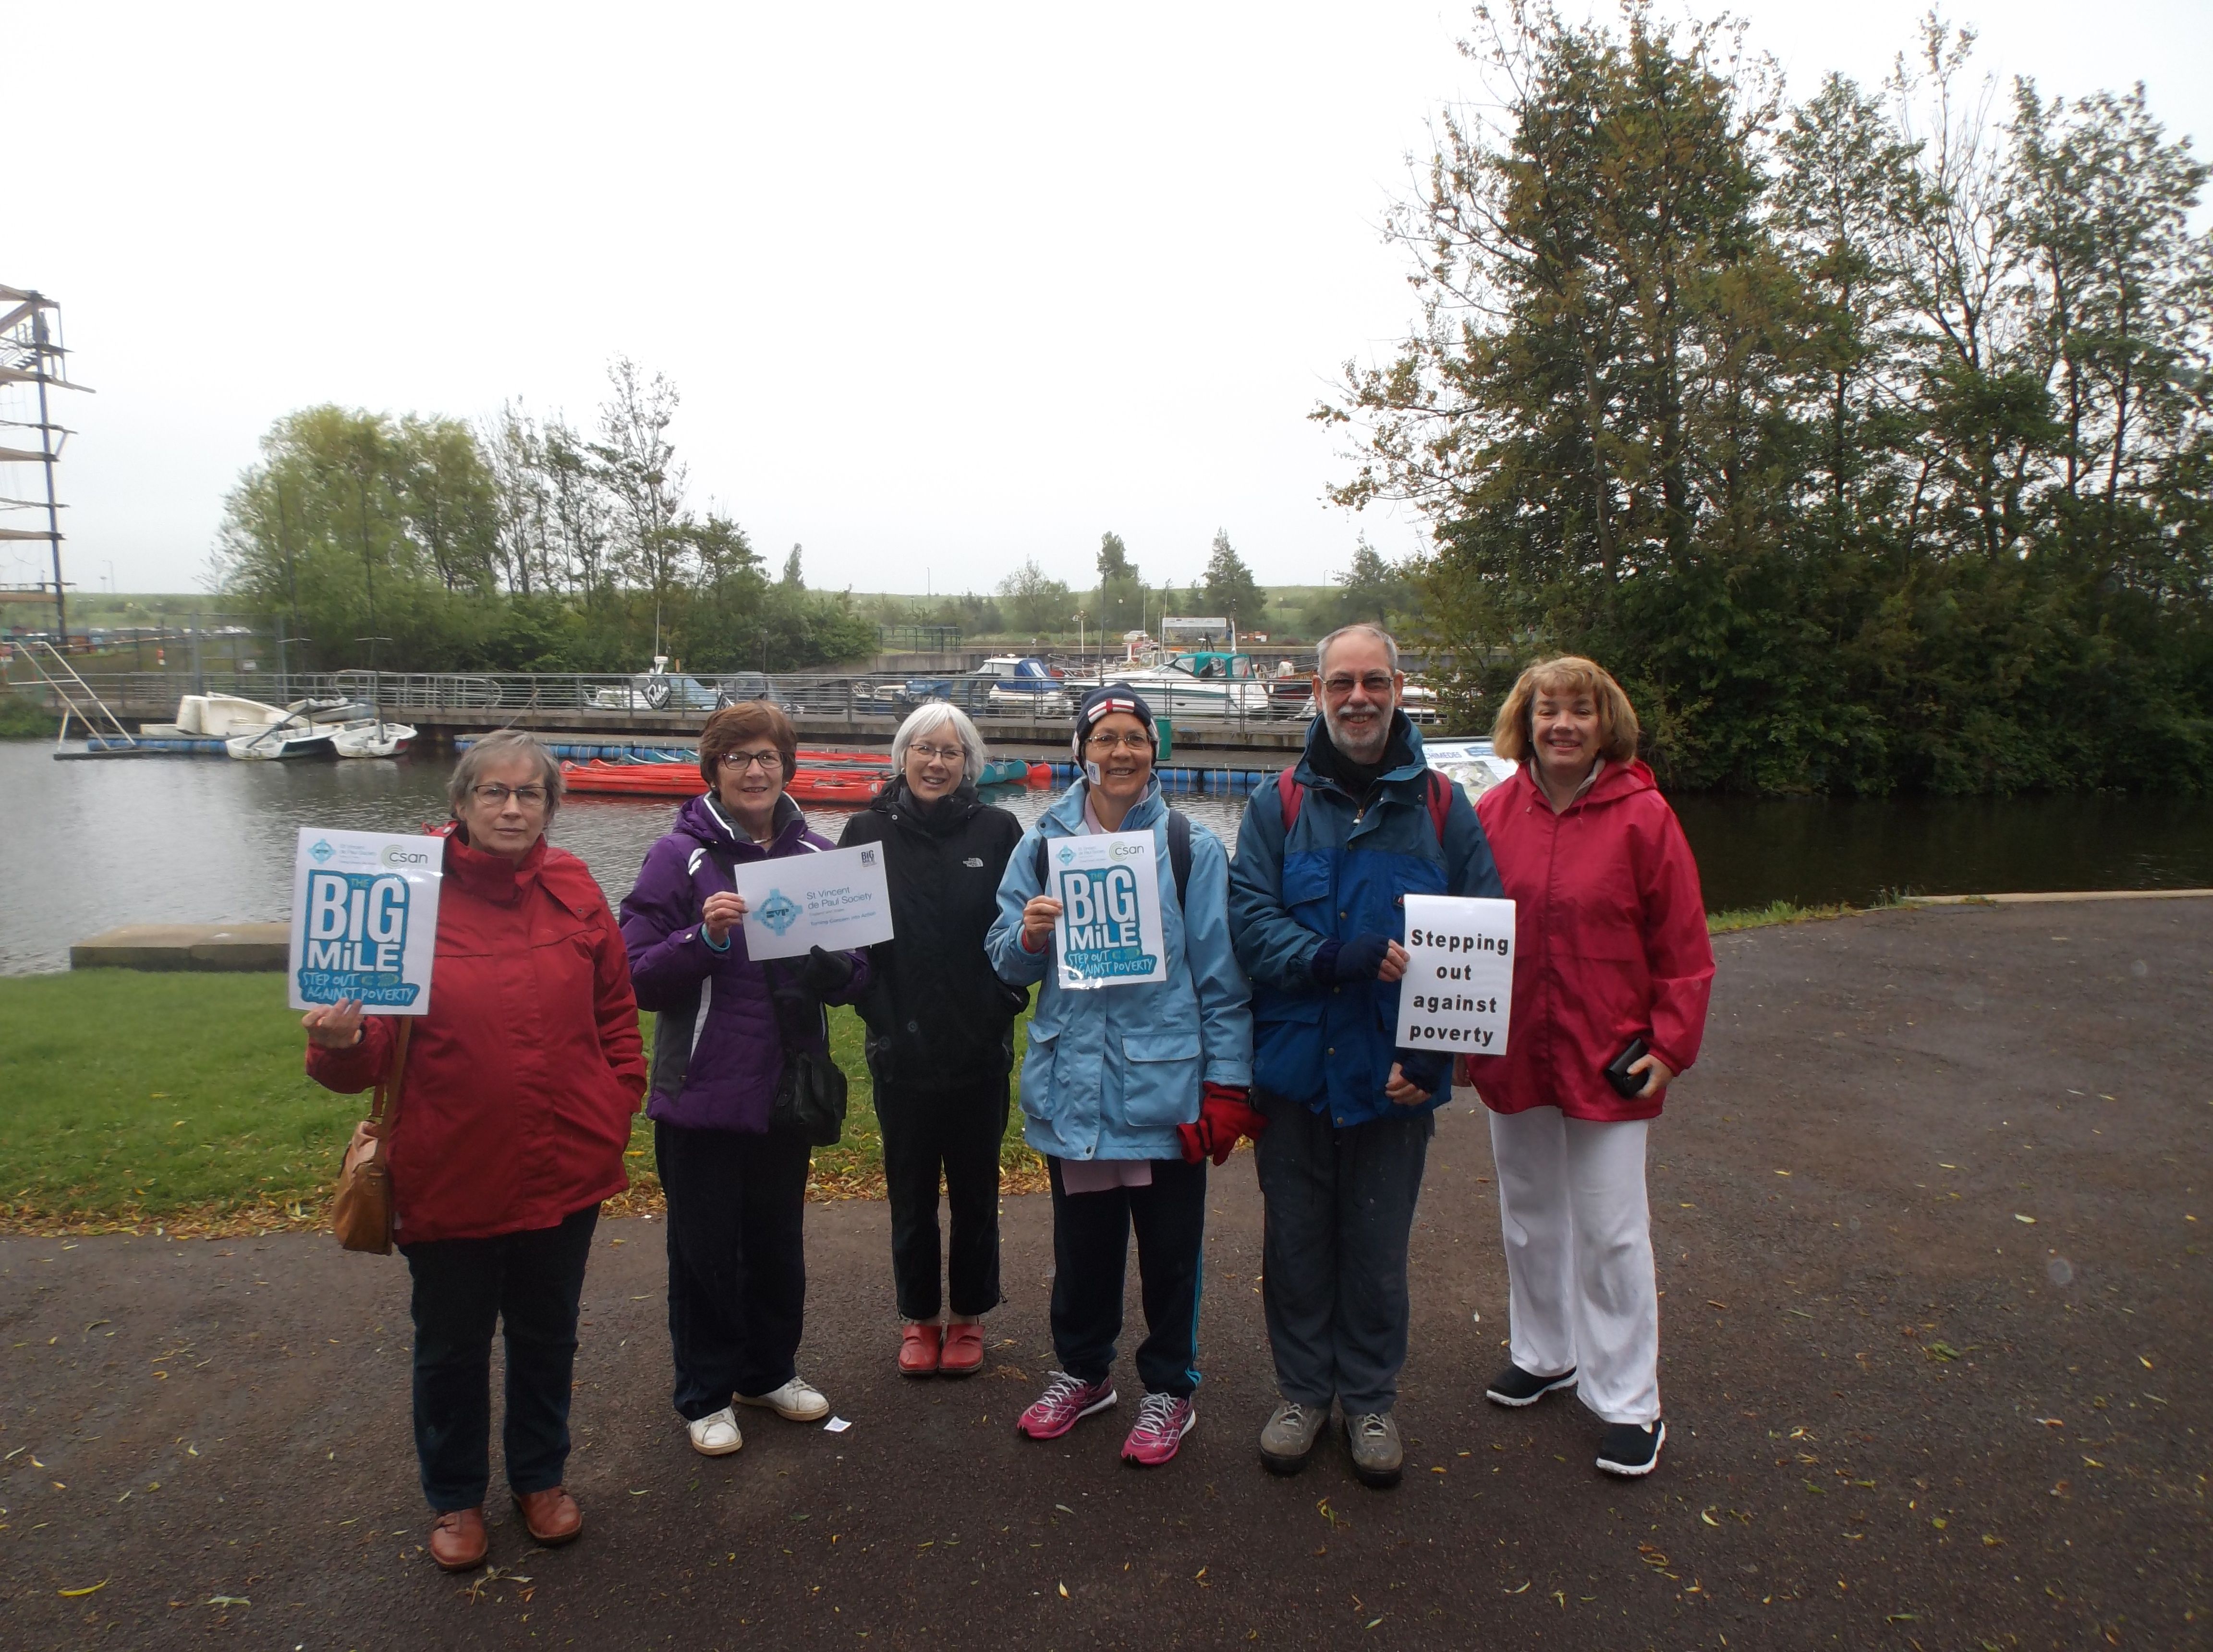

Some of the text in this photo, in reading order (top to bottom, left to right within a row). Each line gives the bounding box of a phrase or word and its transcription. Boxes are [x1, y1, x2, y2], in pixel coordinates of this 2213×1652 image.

[389, 851, 428, 864] csan
[1115, 845, 1144, 856] csan
[350, 878, 370, 888] THE
[807, 887, 850, 900] St Vincent
[808, 892, 872, 910] de Paul Society
[1064, 869, 1135, 926] BIG
[310, 875, 405, 942] BIG
[1410, 928, 1508, 956] Stepping
[1068, 949, 1110, 966] STEP OUT
[1114, 959, 1153, 973] POVERTY
[303, 972, 360, 986] STEP OUT
[1436, 964, 1471, 981] out
[306, 986, 415, 1002] AGAINST POVERTY
[1413, 994, 1497, 1014] against
[1410, 1024, 1494, 1047] poverty
